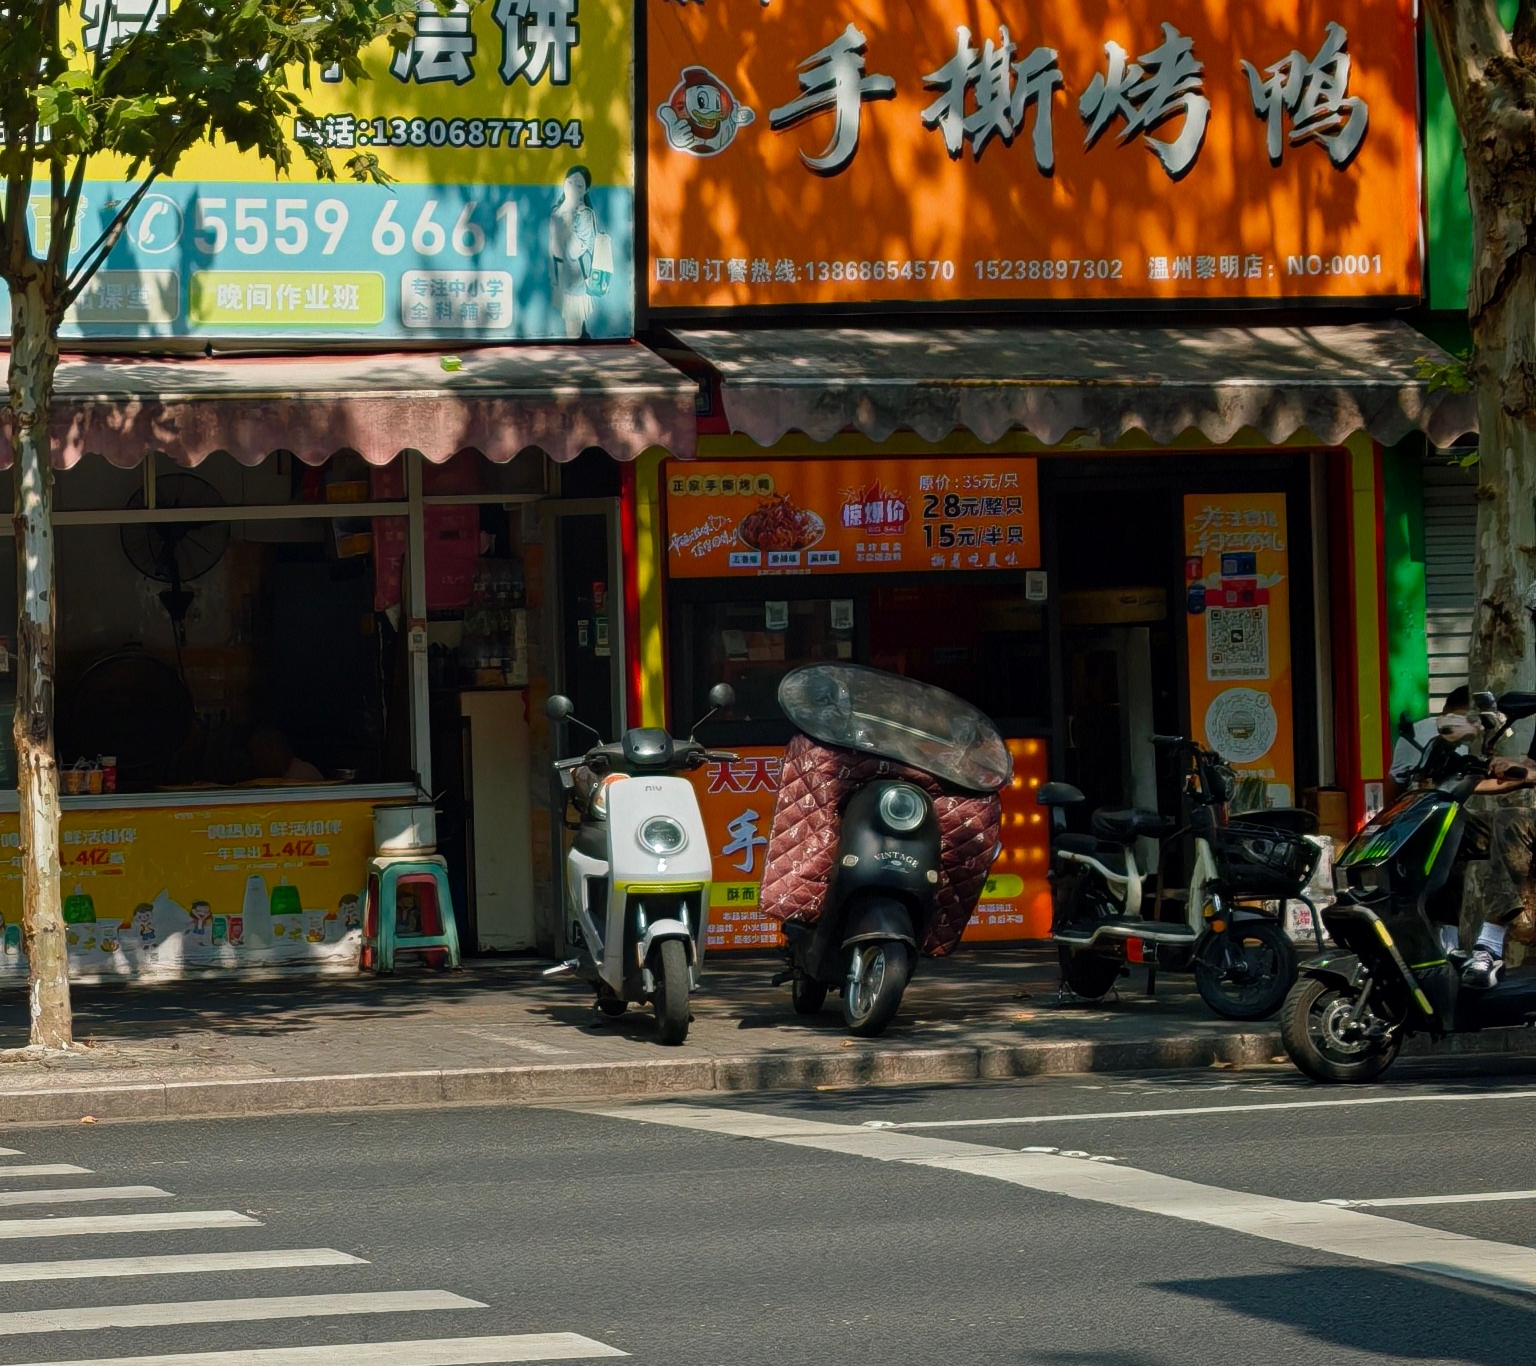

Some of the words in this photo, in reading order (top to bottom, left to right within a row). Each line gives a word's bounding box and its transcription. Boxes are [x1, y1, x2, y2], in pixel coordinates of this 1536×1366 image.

[769, 21, 1370, 180] 手撕烤鸭
[193, 197, 349, 256] 5559
[370, 198, 518, 257] 6661
[973, 258, 1123, 281] 15238897302
[215, 283, 361, 312] 晚间作业班
[409, 277, 505, 299] 专注中小学
[409, 300, 505, 323] 全科辅导
[842, 498, 906, 527] 惊爆价
[921, 493, 1025, 520] 28元/整只
[922, 523, 1025, 550] 15元/半只
[873, 851, 920, 869] VINTAGE
